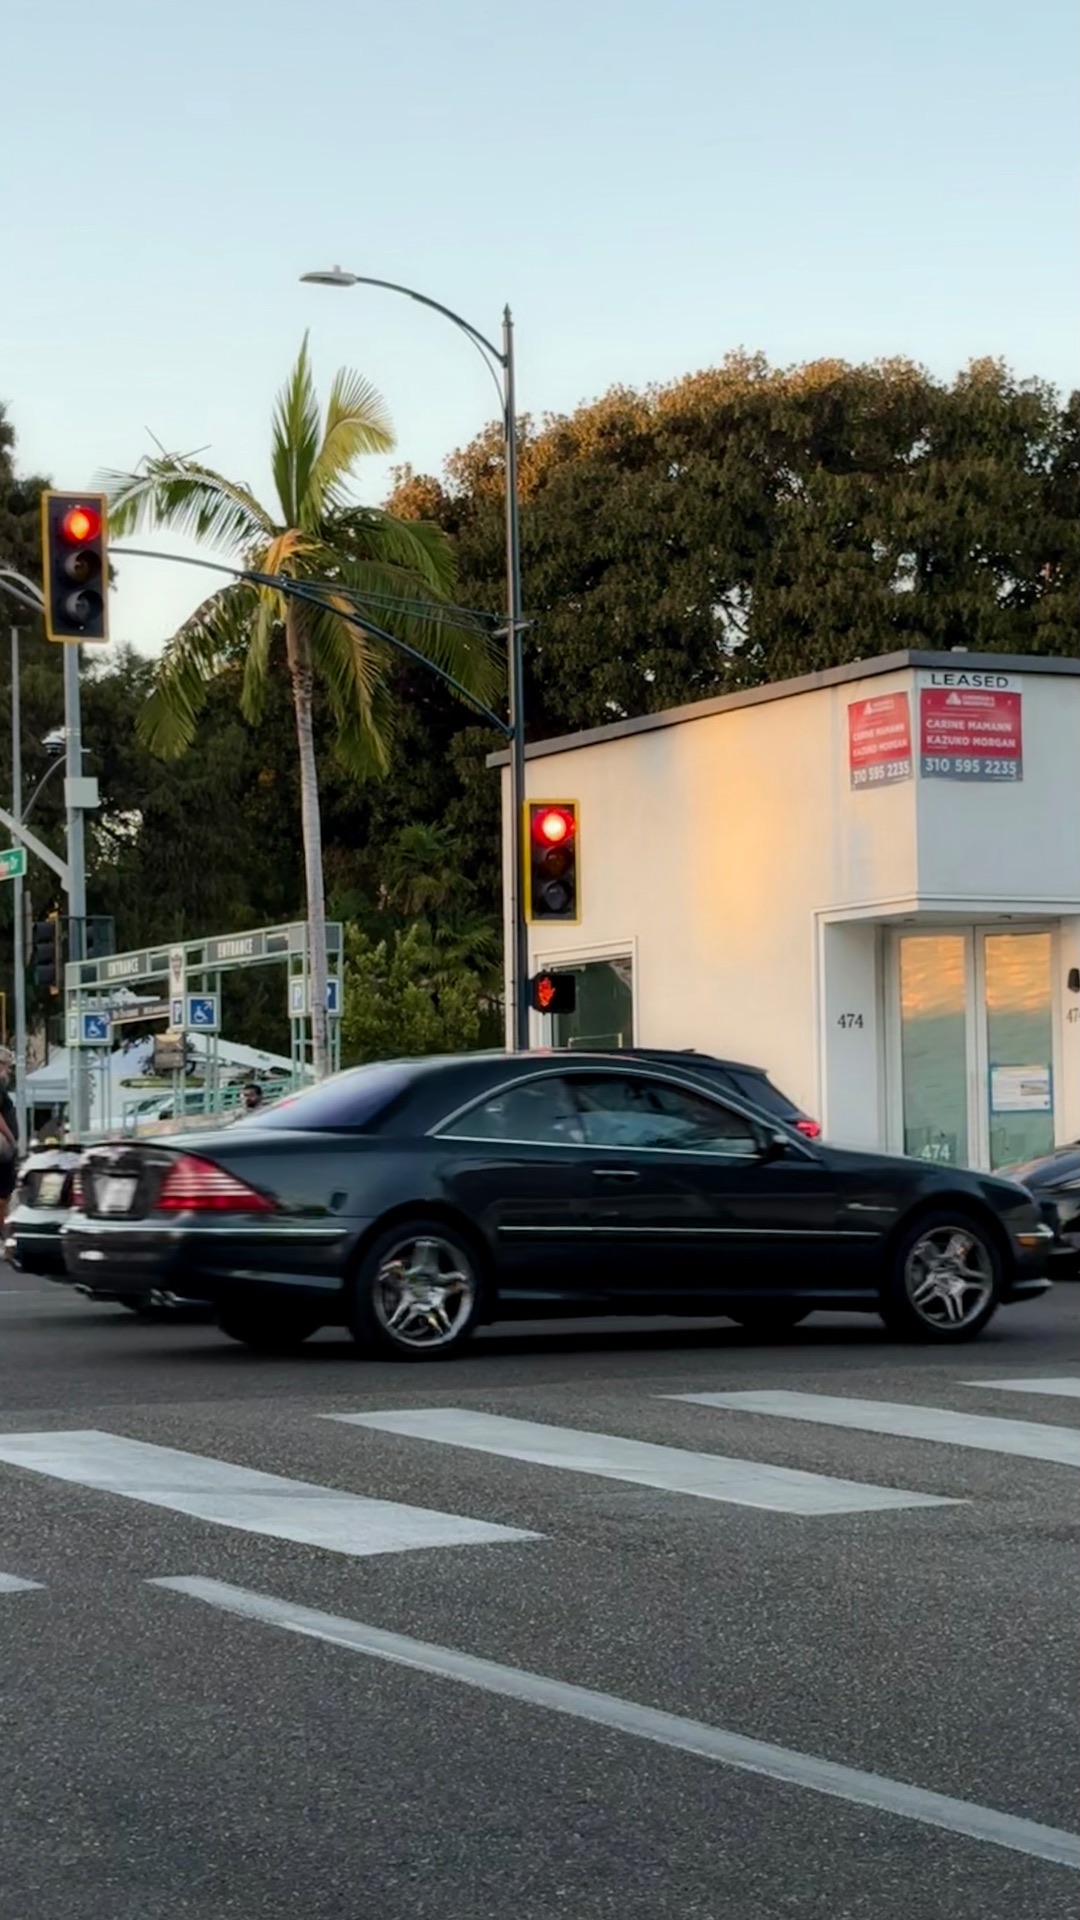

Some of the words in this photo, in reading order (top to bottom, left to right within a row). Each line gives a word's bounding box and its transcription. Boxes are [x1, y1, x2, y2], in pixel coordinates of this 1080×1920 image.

[931, 673, 1009, 688] LEASED
[926, 719, 965, 730] CARINE
[926, 735, 970, 746] KAZUKO
[972, 736, 1016, 748] MORGAN
[853, 770, 866, 785] 310
[869, 766, 885, 780] 595
[887, 762, 910, 776] 2235
[925, 758, 950, 772] 310
[955, 759, 980, 773] 595
[985, 760, 1017, 775] 2235
[217, 938, 253, 958] ENTRANCE
[107, 957, 139, 976] ENTRANCE
[837, 1013, 864, 1029] 474
[1065, 1007, 1080, 1024] 47
[921, 1144, 950, 1160] 474
